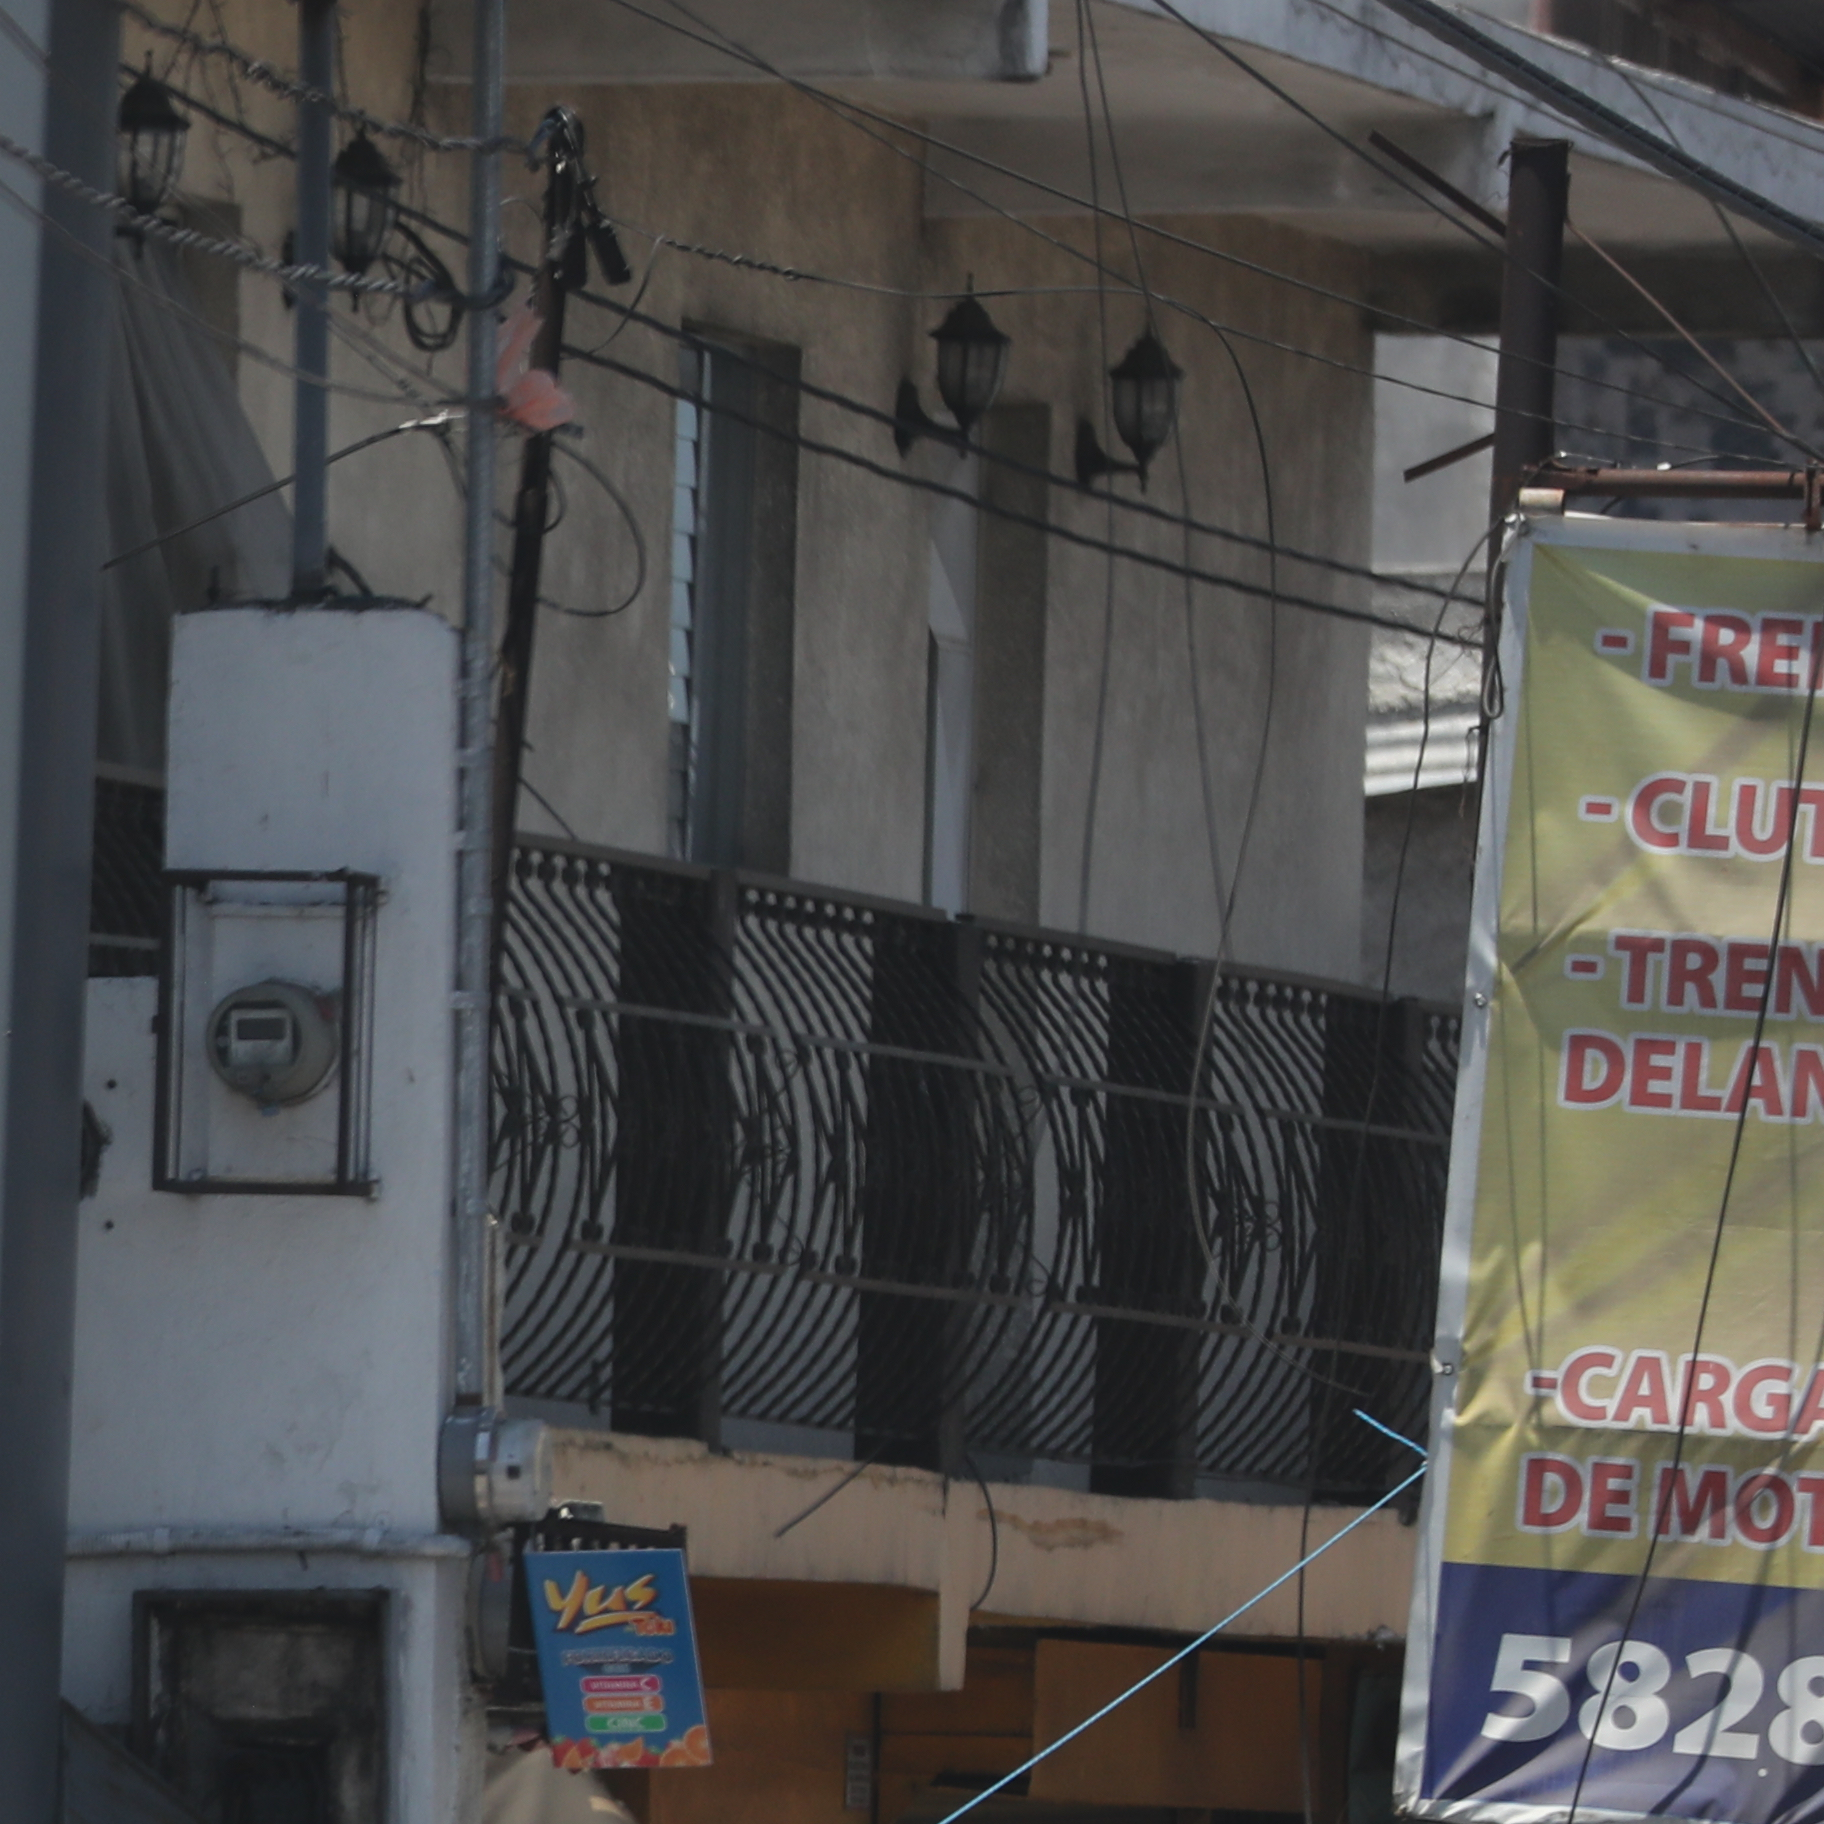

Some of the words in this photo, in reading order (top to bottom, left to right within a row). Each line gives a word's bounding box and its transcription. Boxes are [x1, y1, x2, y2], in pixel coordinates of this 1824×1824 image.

[1649, 611, 1824, 691] FRE
[1615, 935, 1824, 1017] TREN
[1565, 1033, 1824, 1118] DELAN
[1522, 1457, 1635, 1533] DE
[544, 1570, 658, 1630] Yus
[1481, 1632, 1824, 1766] 5828
